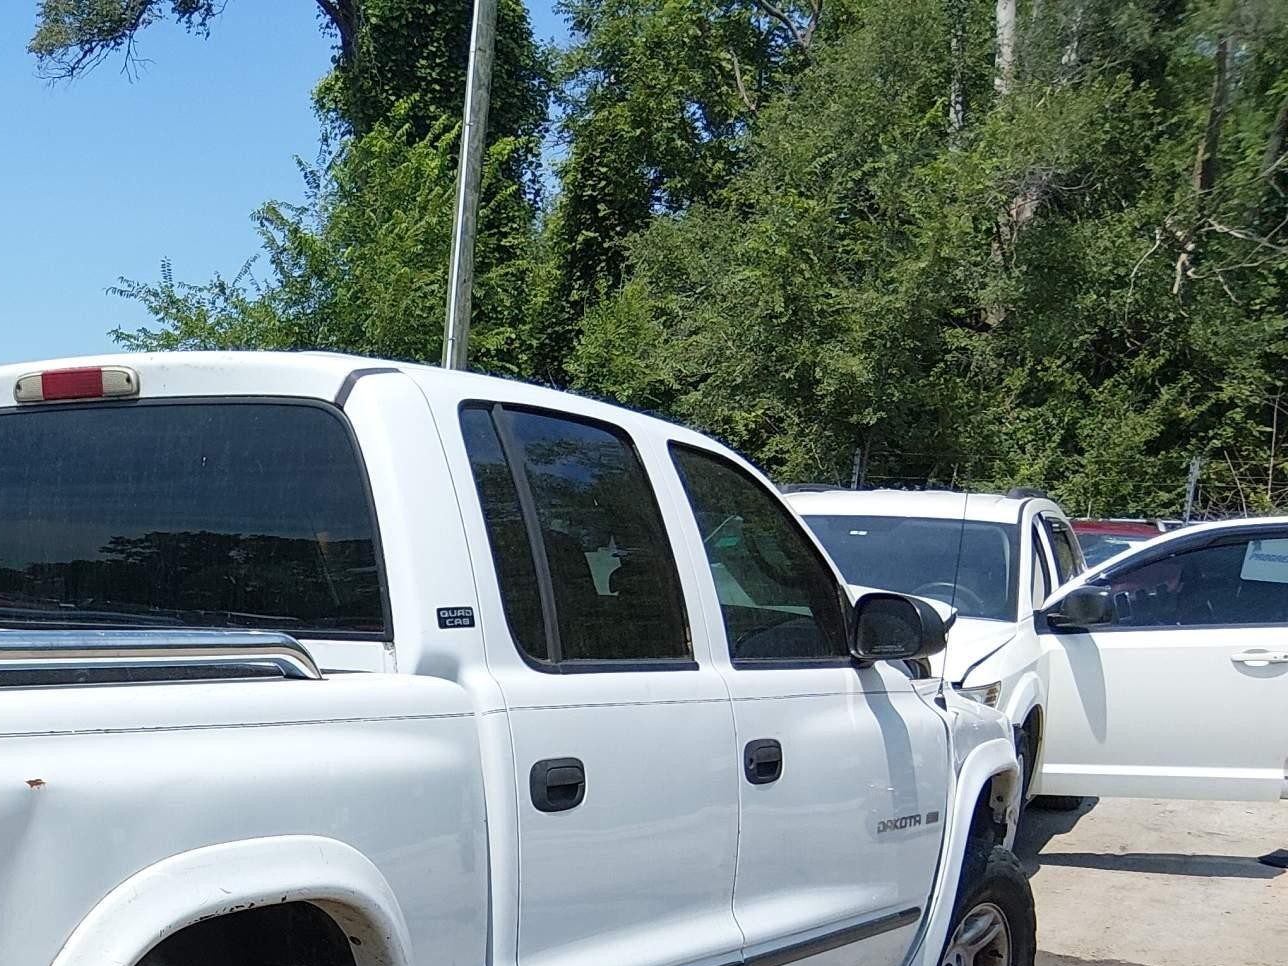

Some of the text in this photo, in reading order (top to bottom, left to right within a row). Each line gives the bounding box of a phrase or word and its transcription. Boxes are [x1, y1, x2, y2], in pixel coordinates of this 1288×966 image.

[440, 609, 472, 617] QUAD
[446, 618, 470, 626] CAB
[877, 814, 922, 834] DAKOTA
